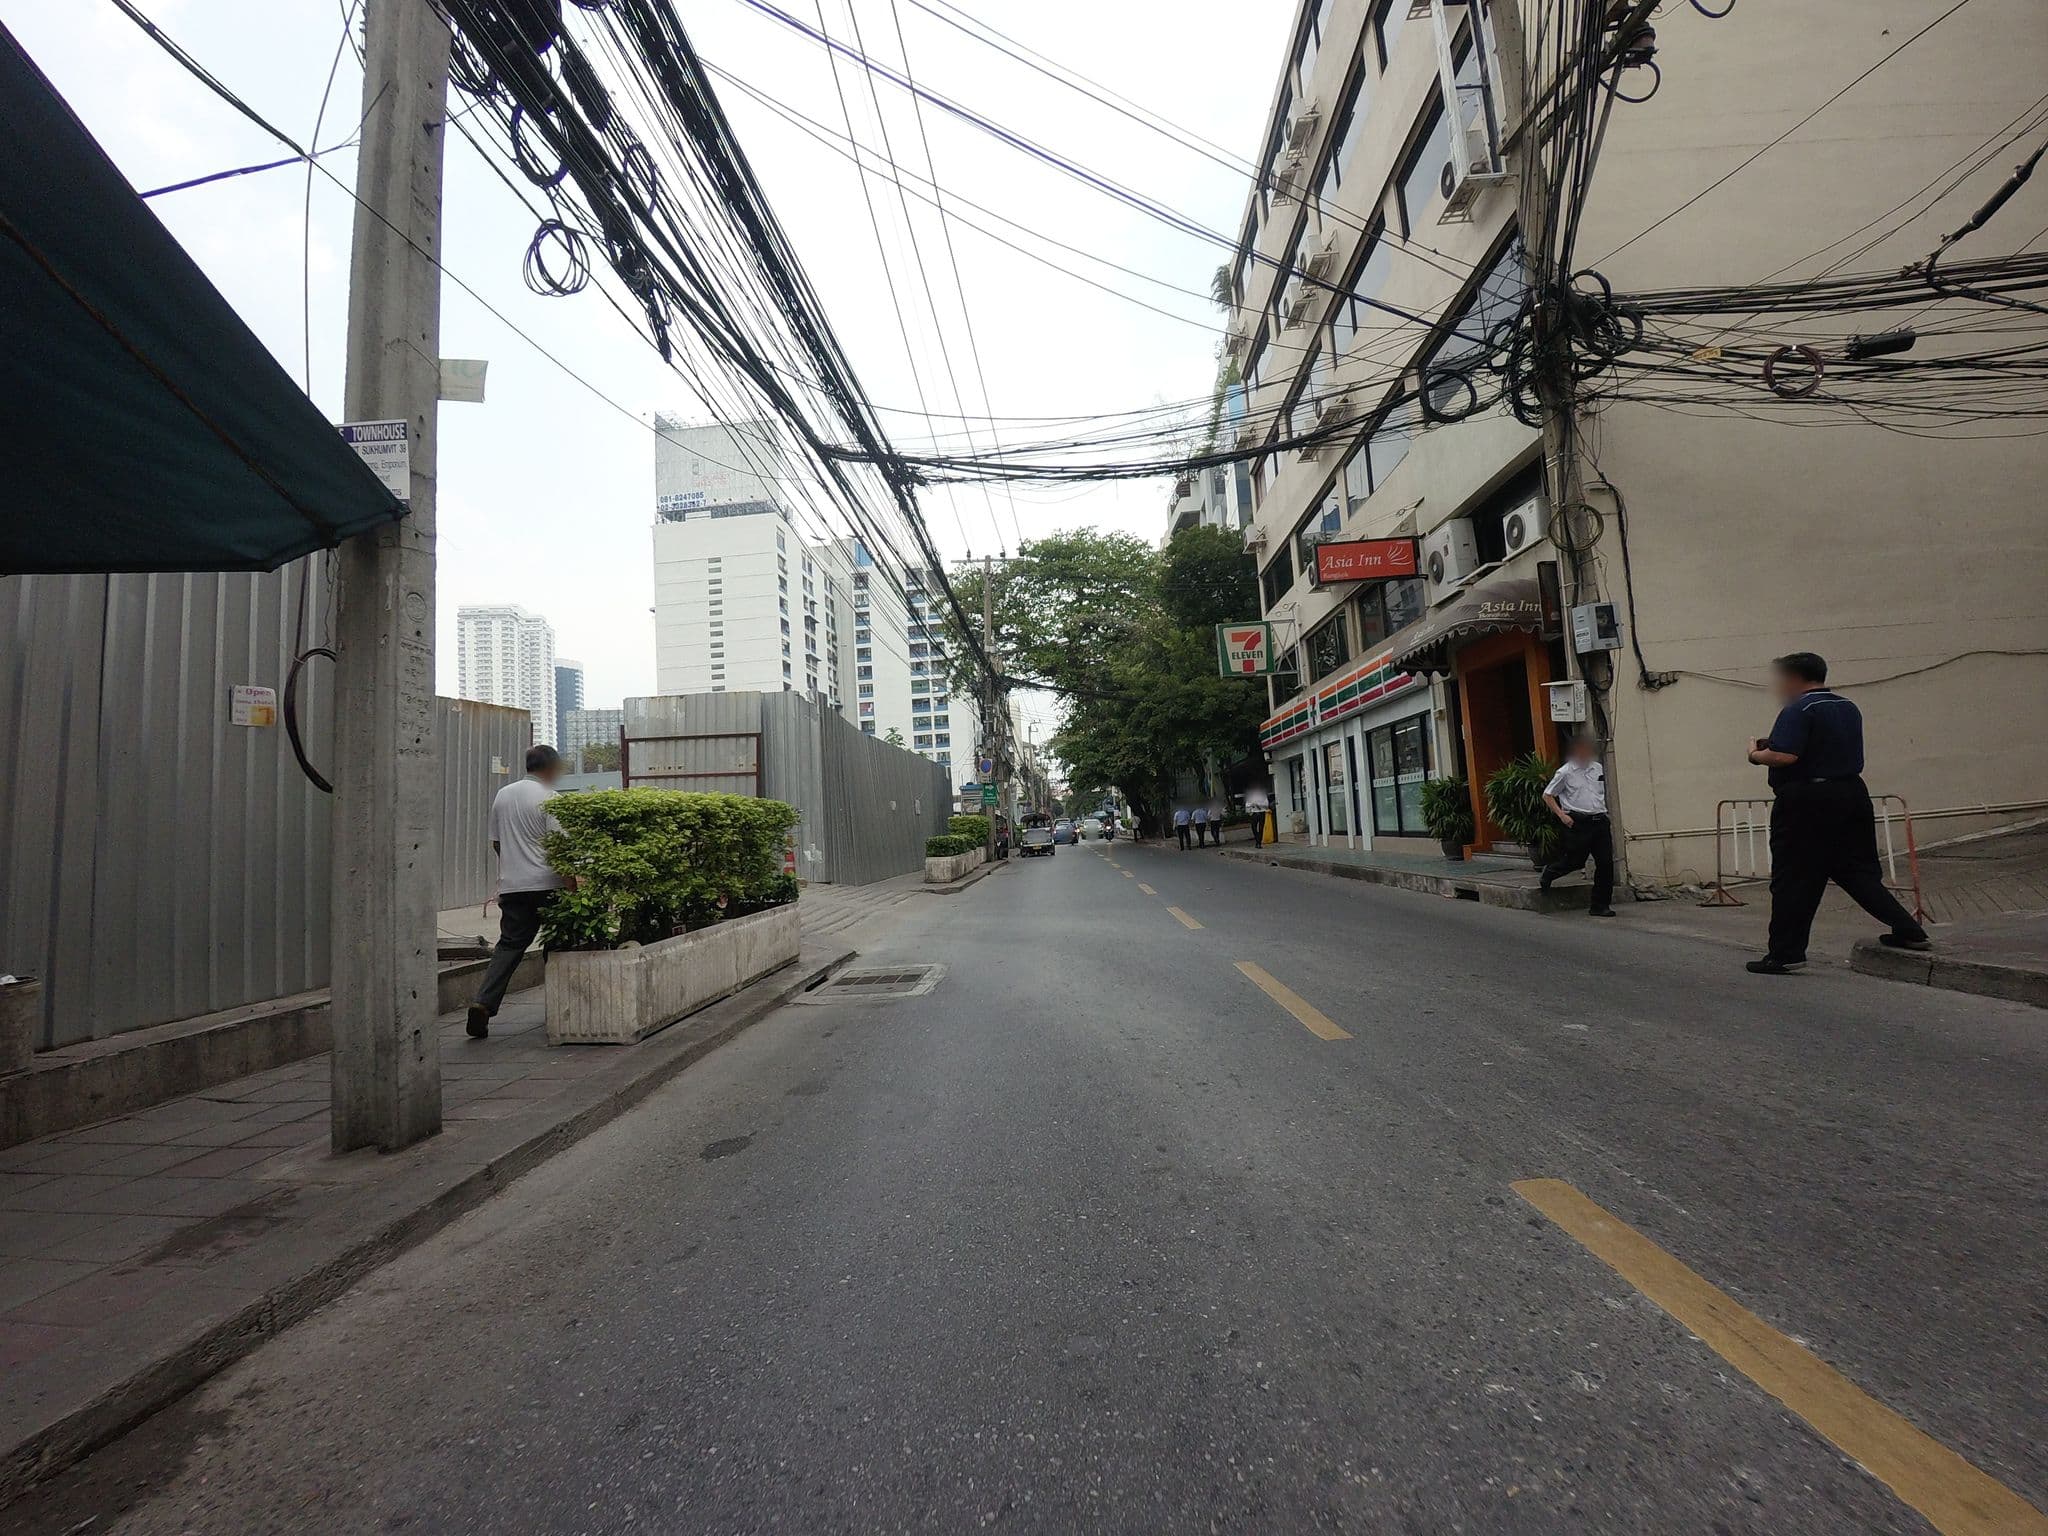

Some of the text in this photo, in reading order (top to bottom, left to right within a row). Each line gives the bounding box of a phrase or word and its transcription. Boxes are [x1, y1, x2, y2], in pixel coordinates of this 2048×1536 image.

[352, 424, 405, 441] TOWNHOUSE
[362, 445, 396, 455] SUKHUMVIT
[1320, 552, 1382, 571] Asia Inn
[1478, 599, 1542, 614] Asia Inn
